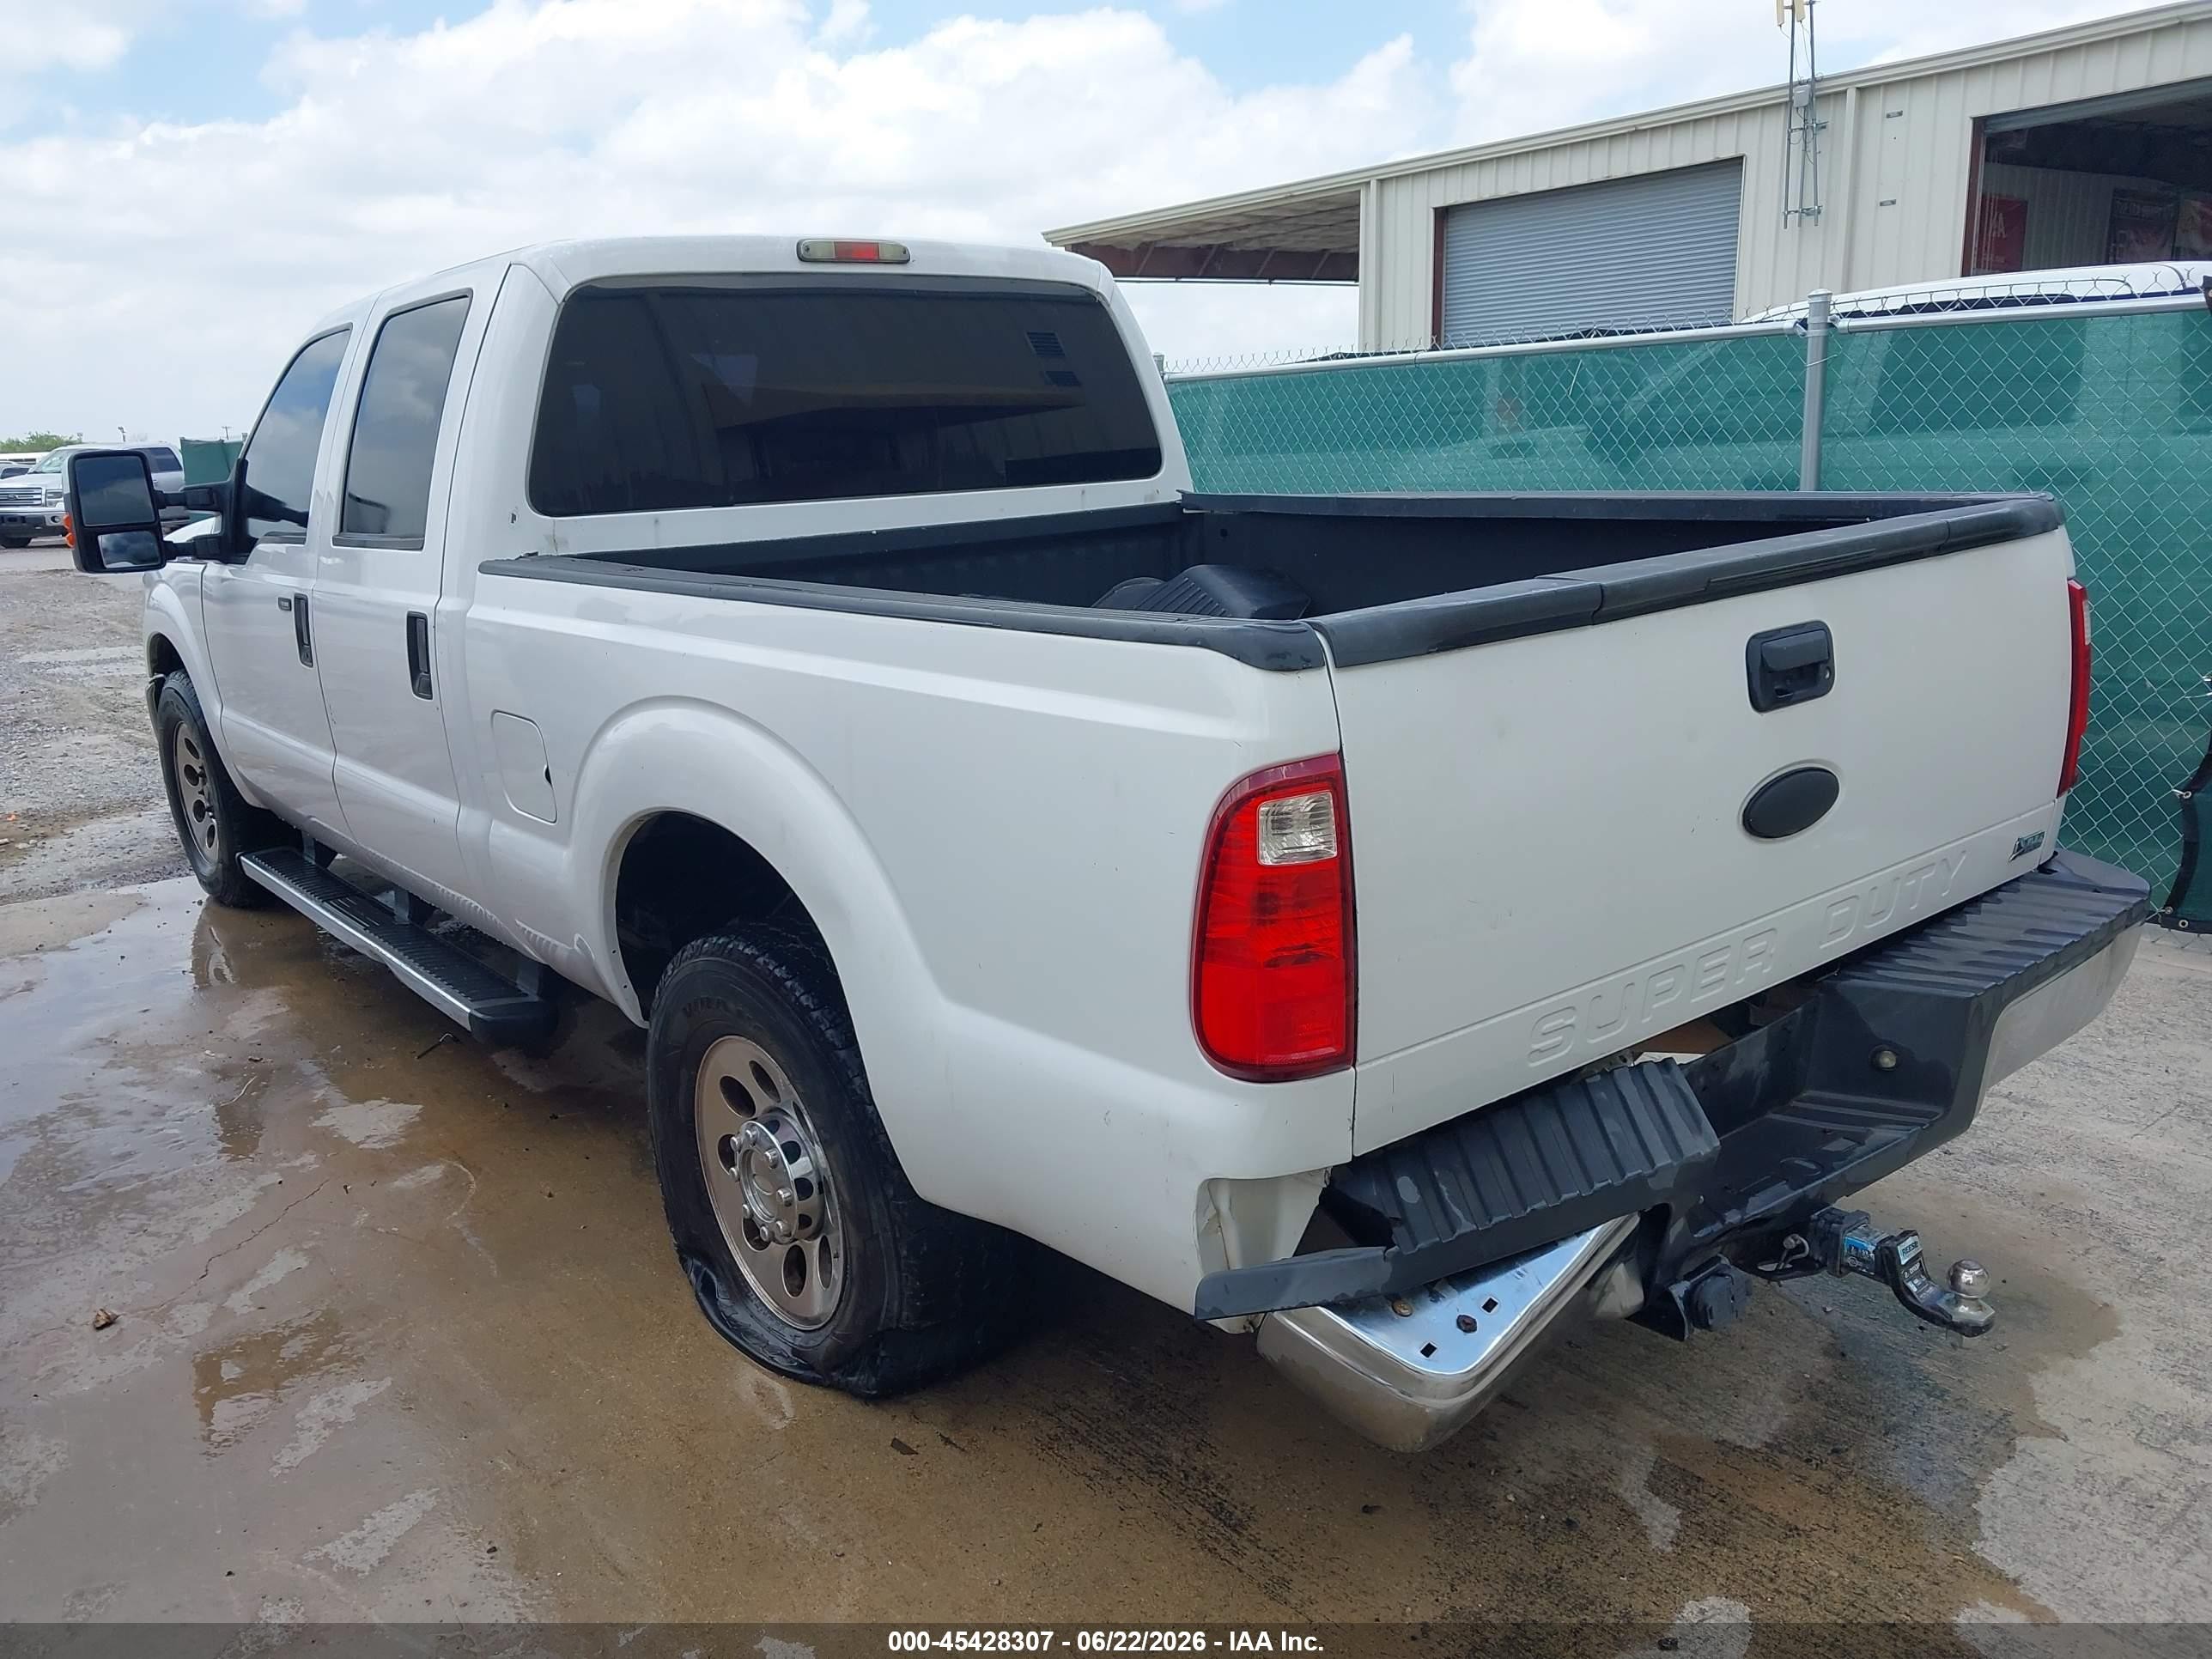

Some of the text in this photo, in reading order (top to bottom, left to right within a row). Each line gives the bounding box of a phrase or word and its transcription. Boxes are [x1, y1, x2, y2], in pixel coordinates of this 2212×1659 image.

[1528, 849, 1968, 1068] SUPER DUTY
[1902, 1241, 1919, 1256] REESE
